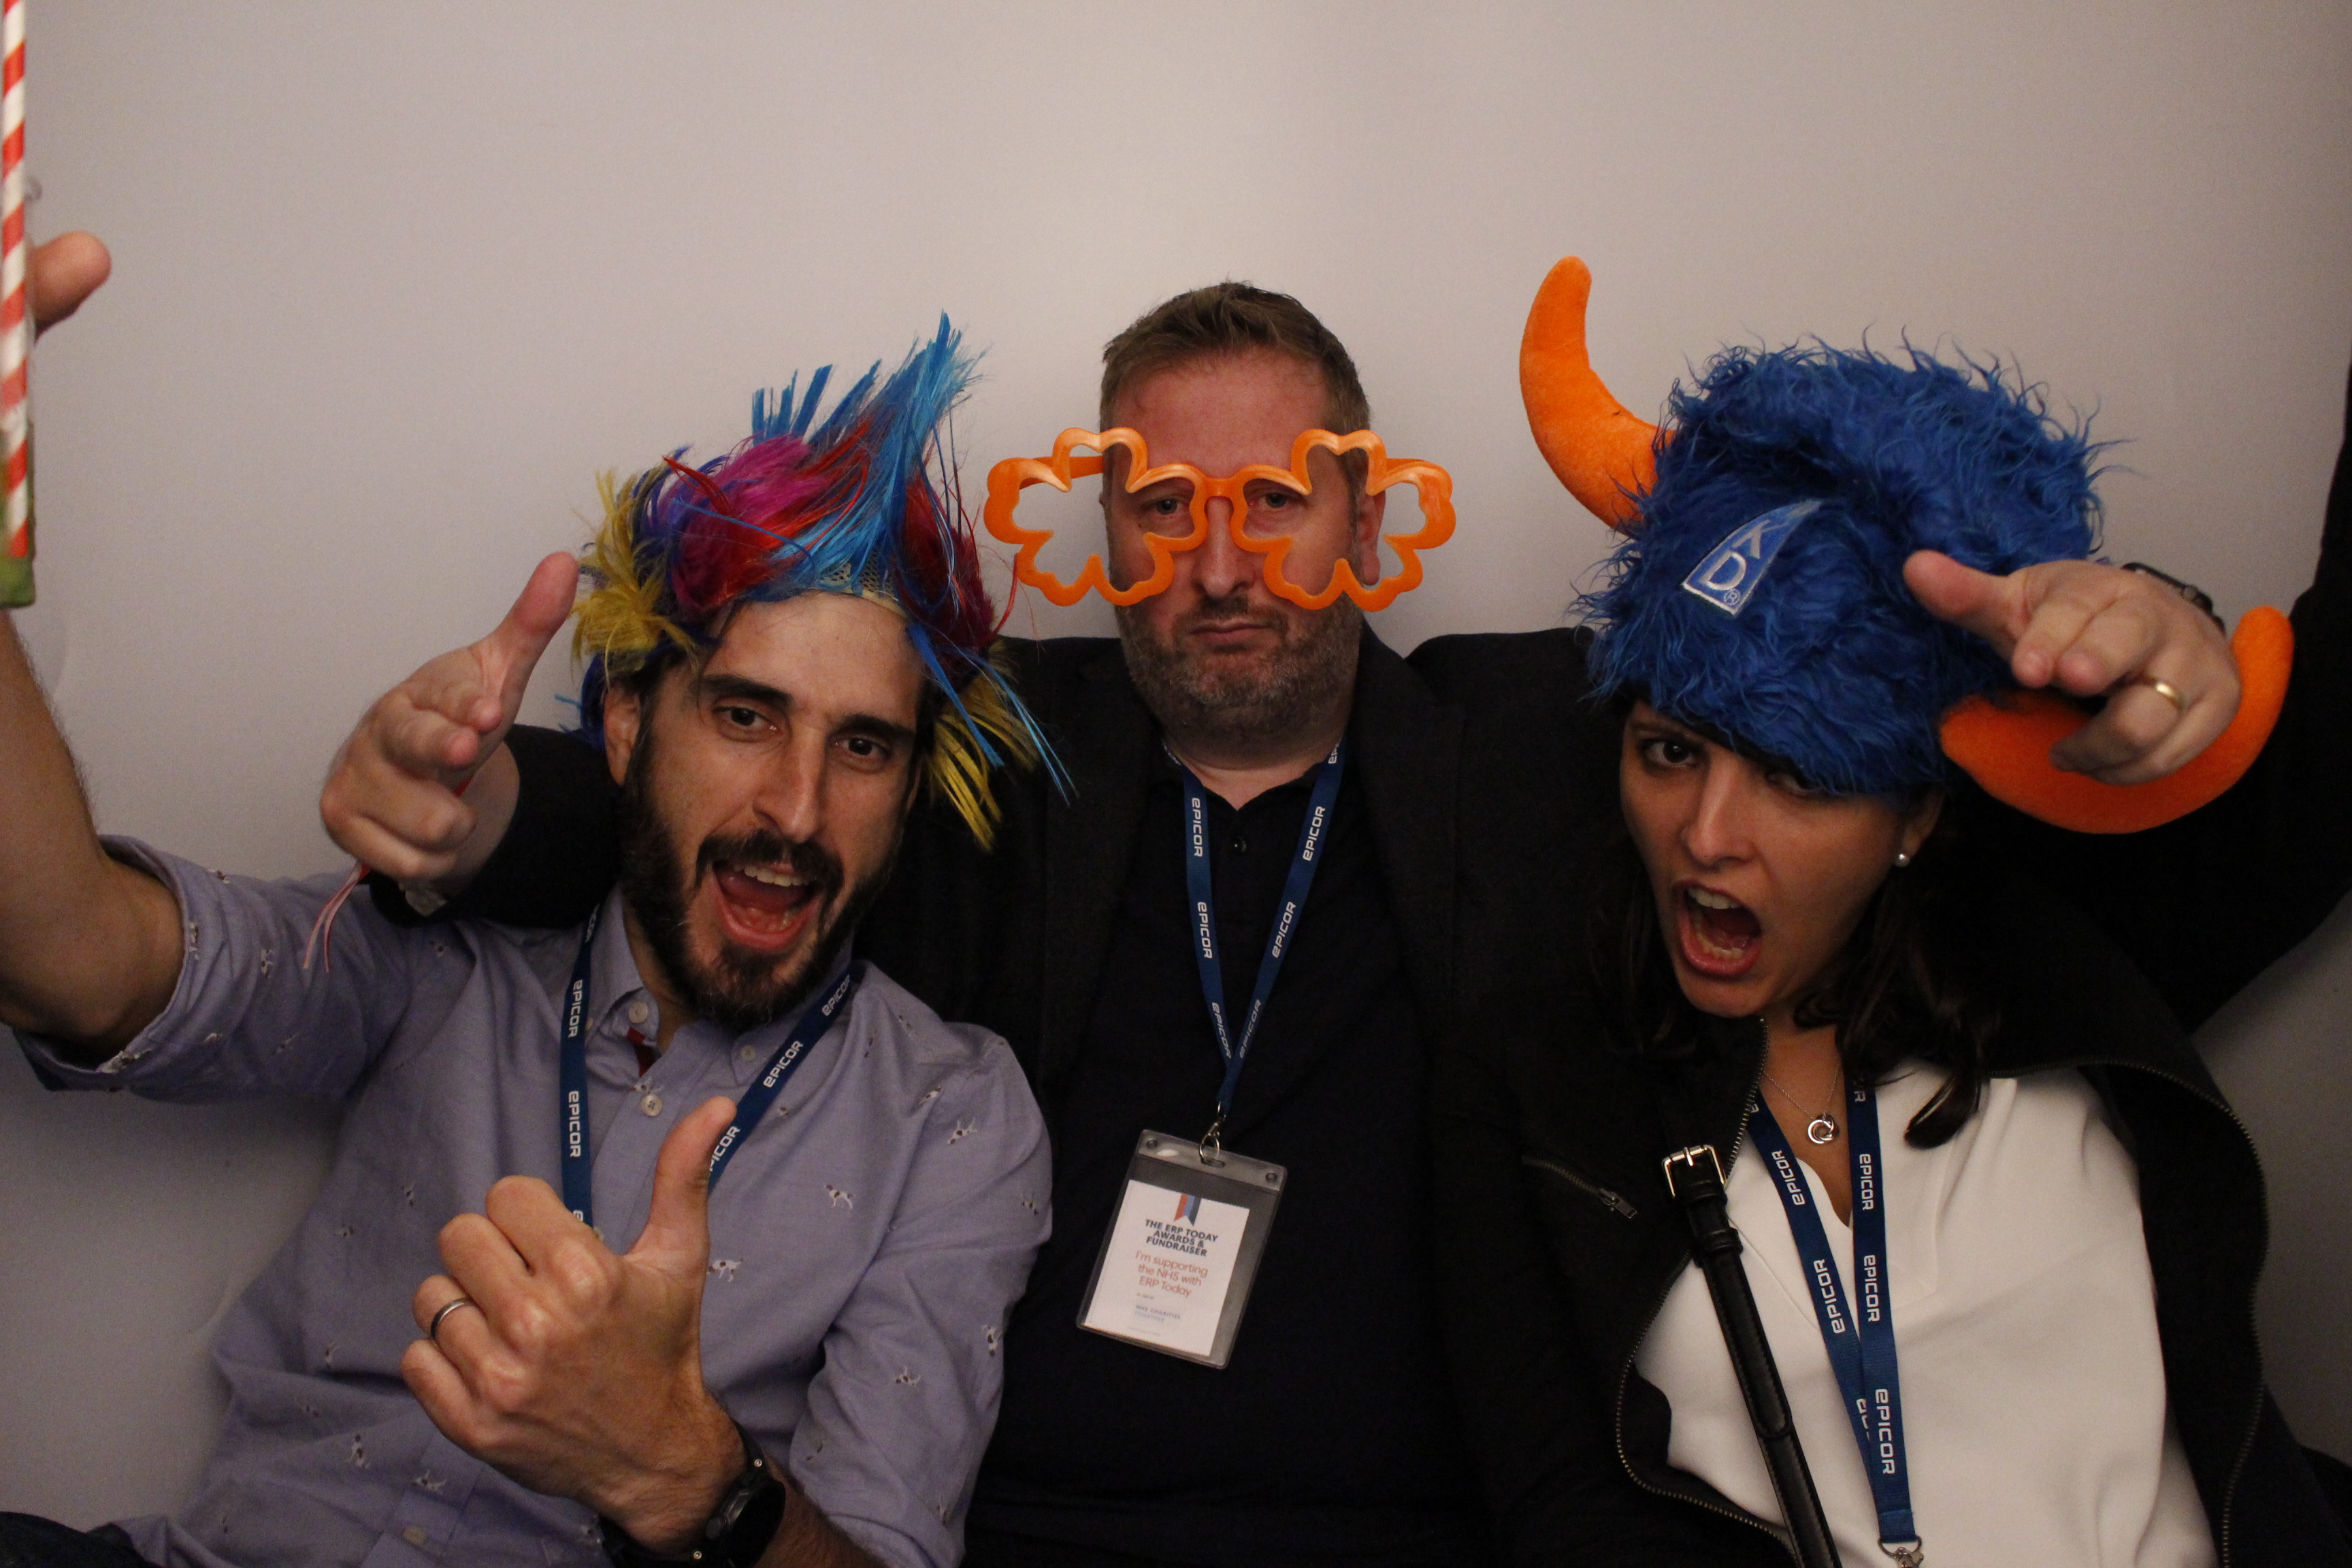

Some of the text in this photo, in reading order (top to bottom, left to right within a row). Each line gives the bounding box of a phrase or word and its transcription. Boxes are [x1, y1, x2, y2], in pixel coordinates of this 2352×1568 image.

[1145, 1219, 1218, 1242] THE ERP TODAY
[1154, 1230, 1204, 1248] AWARDS &
[1146, 1236, 1207, 1257] FUNDRAISER
[1135, 1251, 1209, 1278] I'm supporting
[1138, 1264, 1202, 1286] the NHS with
[1139, 1276, 1159, 1288] ERP
[1162, 1281, 1192, 1298] Today
